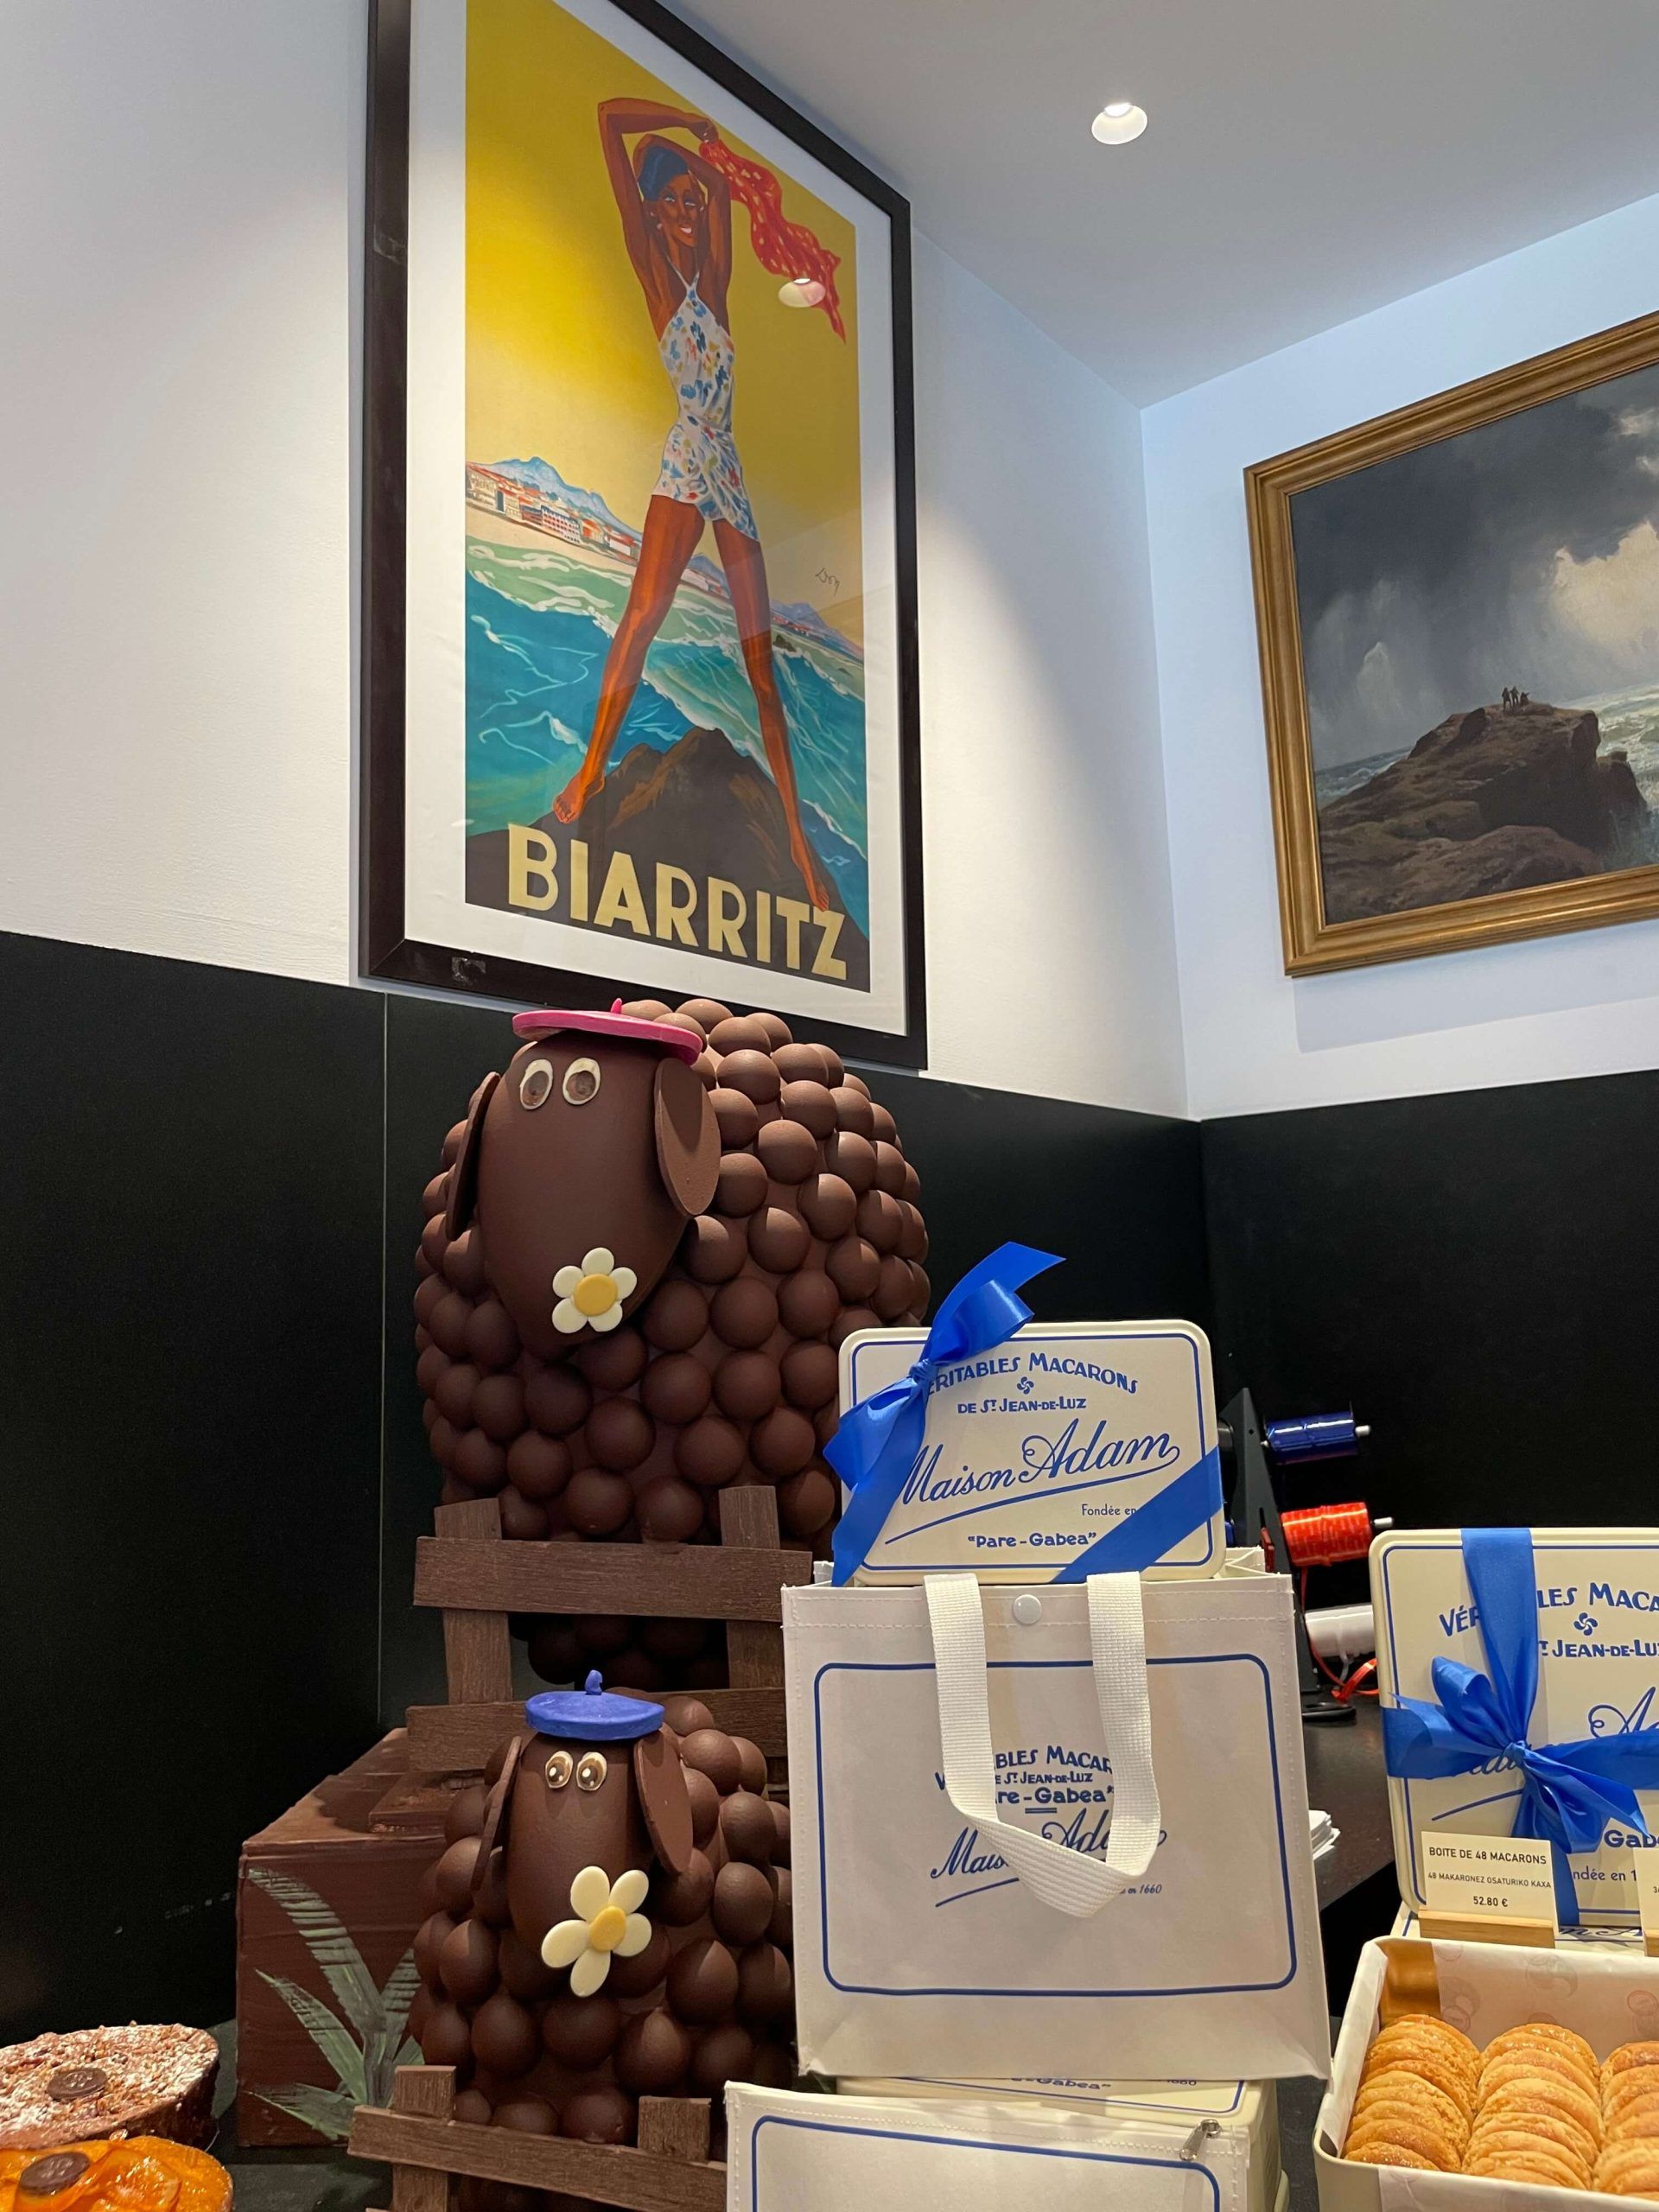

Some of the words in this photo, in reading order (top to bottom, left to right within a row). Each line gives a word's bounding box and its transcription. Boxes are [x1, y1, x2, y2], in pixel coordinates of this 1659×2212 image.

[508, 823, 847, 981] BIARRITZ
[929, 1357, 1021, 1395] RITABLES
[1028, 1352, 1138, 1394] MACARONS
[957, 1402, 976, 1414] DE
[1000, 1396, 1086, 1412] JEAN-DE-LUZ
[903, 1444, 1015, 1504] Maison
[1018, 1418, 1180, 1483] Adam
[1081, 1503, 1121, 1516] Fondée
[1552, 1639, 1659, 1657] JEAN-DE-LU
[1046, 1745, 1114, 1775] MACAR
[1020, 1770, 1093, 1783] JEAN-DE-LUZ
[931, 1826, 1009, 1878] Mais
[1429, 1847, 1457, 1858] BOITE
[1459, 1849, 1472, 1859] DE
[1475, 1851, 1487, 1860] 48
[1490, 1852, 1547, 1865] MACARONS
[1439, 1873, 1484, 1884] MAKARONEZ
[1487, 1877, 1529, 1886] OSATURIKO
[1573, 1865, 1605, 1880] ndée
[1611, 1872, 1626, 1881] en
[1140, 1884, 1162, 1894] 1660
[1473, 1896, 1498, 1907] 52.80
[1502, 1898, 1509, 1907] €
